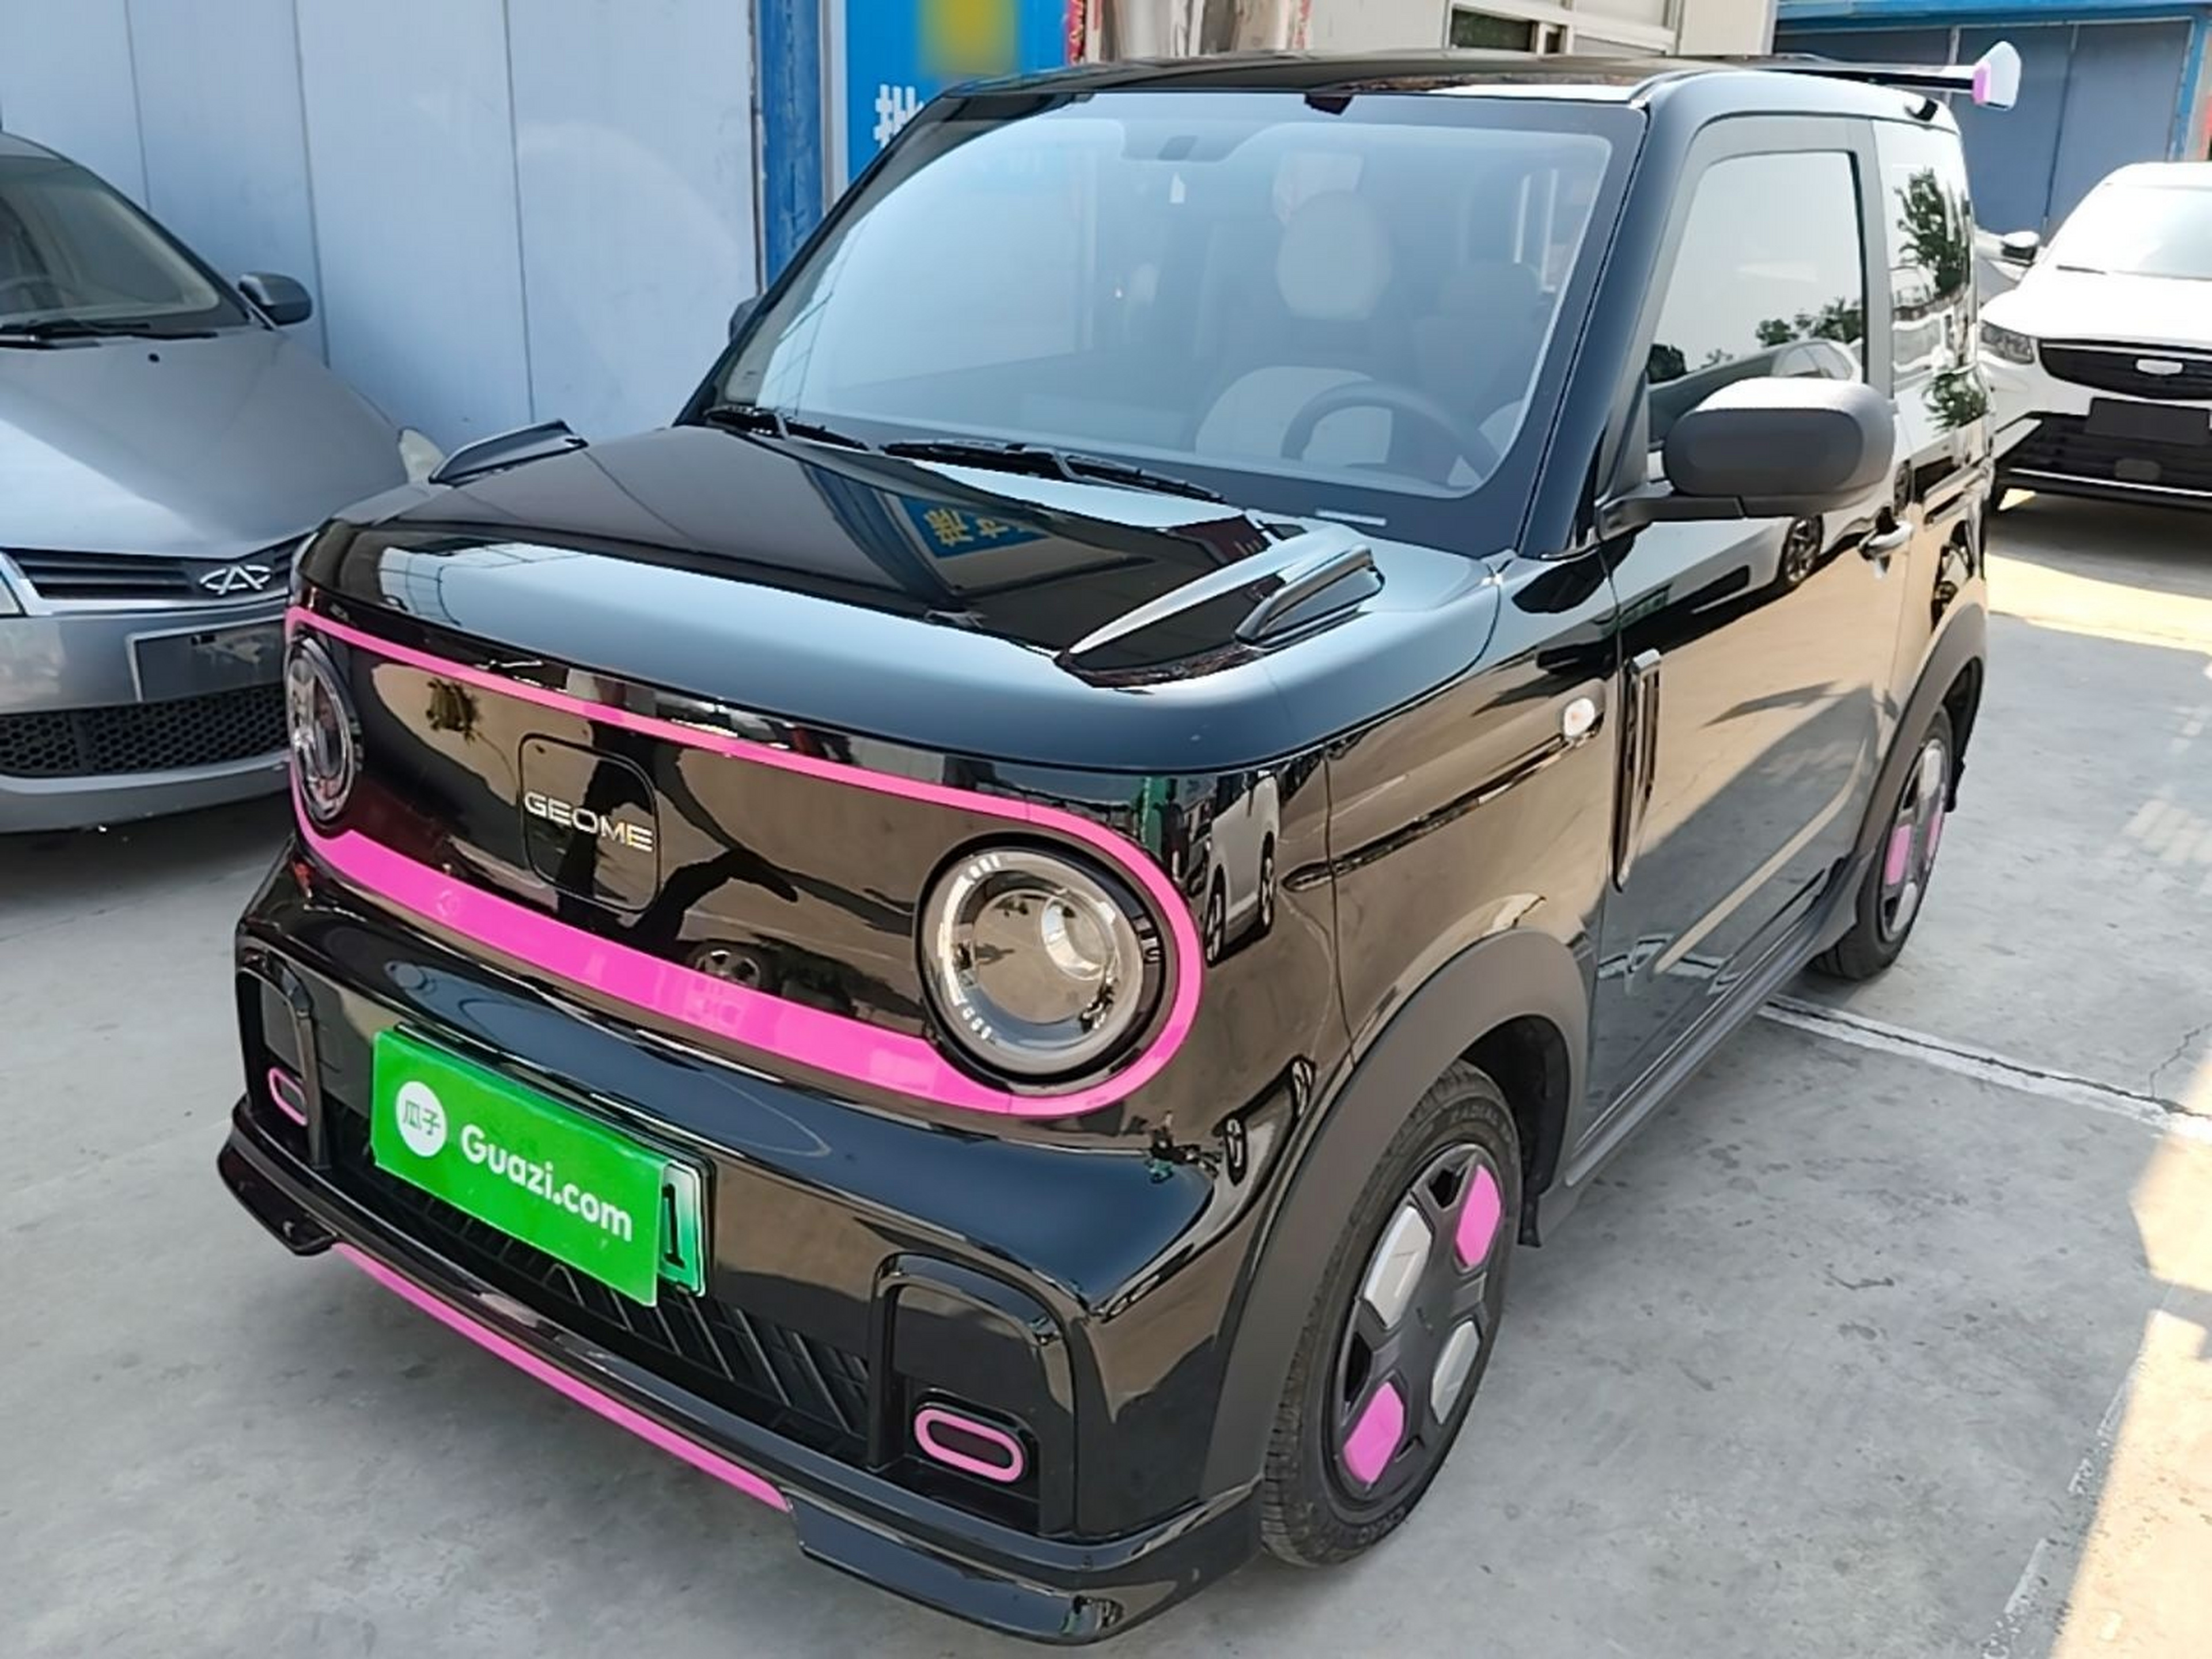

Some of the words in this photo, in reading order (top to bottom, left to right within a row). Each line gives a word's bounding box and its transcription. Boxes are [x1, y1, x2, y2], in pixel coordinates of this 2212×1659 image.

[524, 791, 653, 853] GEOME
[403, 1100, 441, 1137] 瓜子
[461, 1124, 632, 1242] Guazi.com
